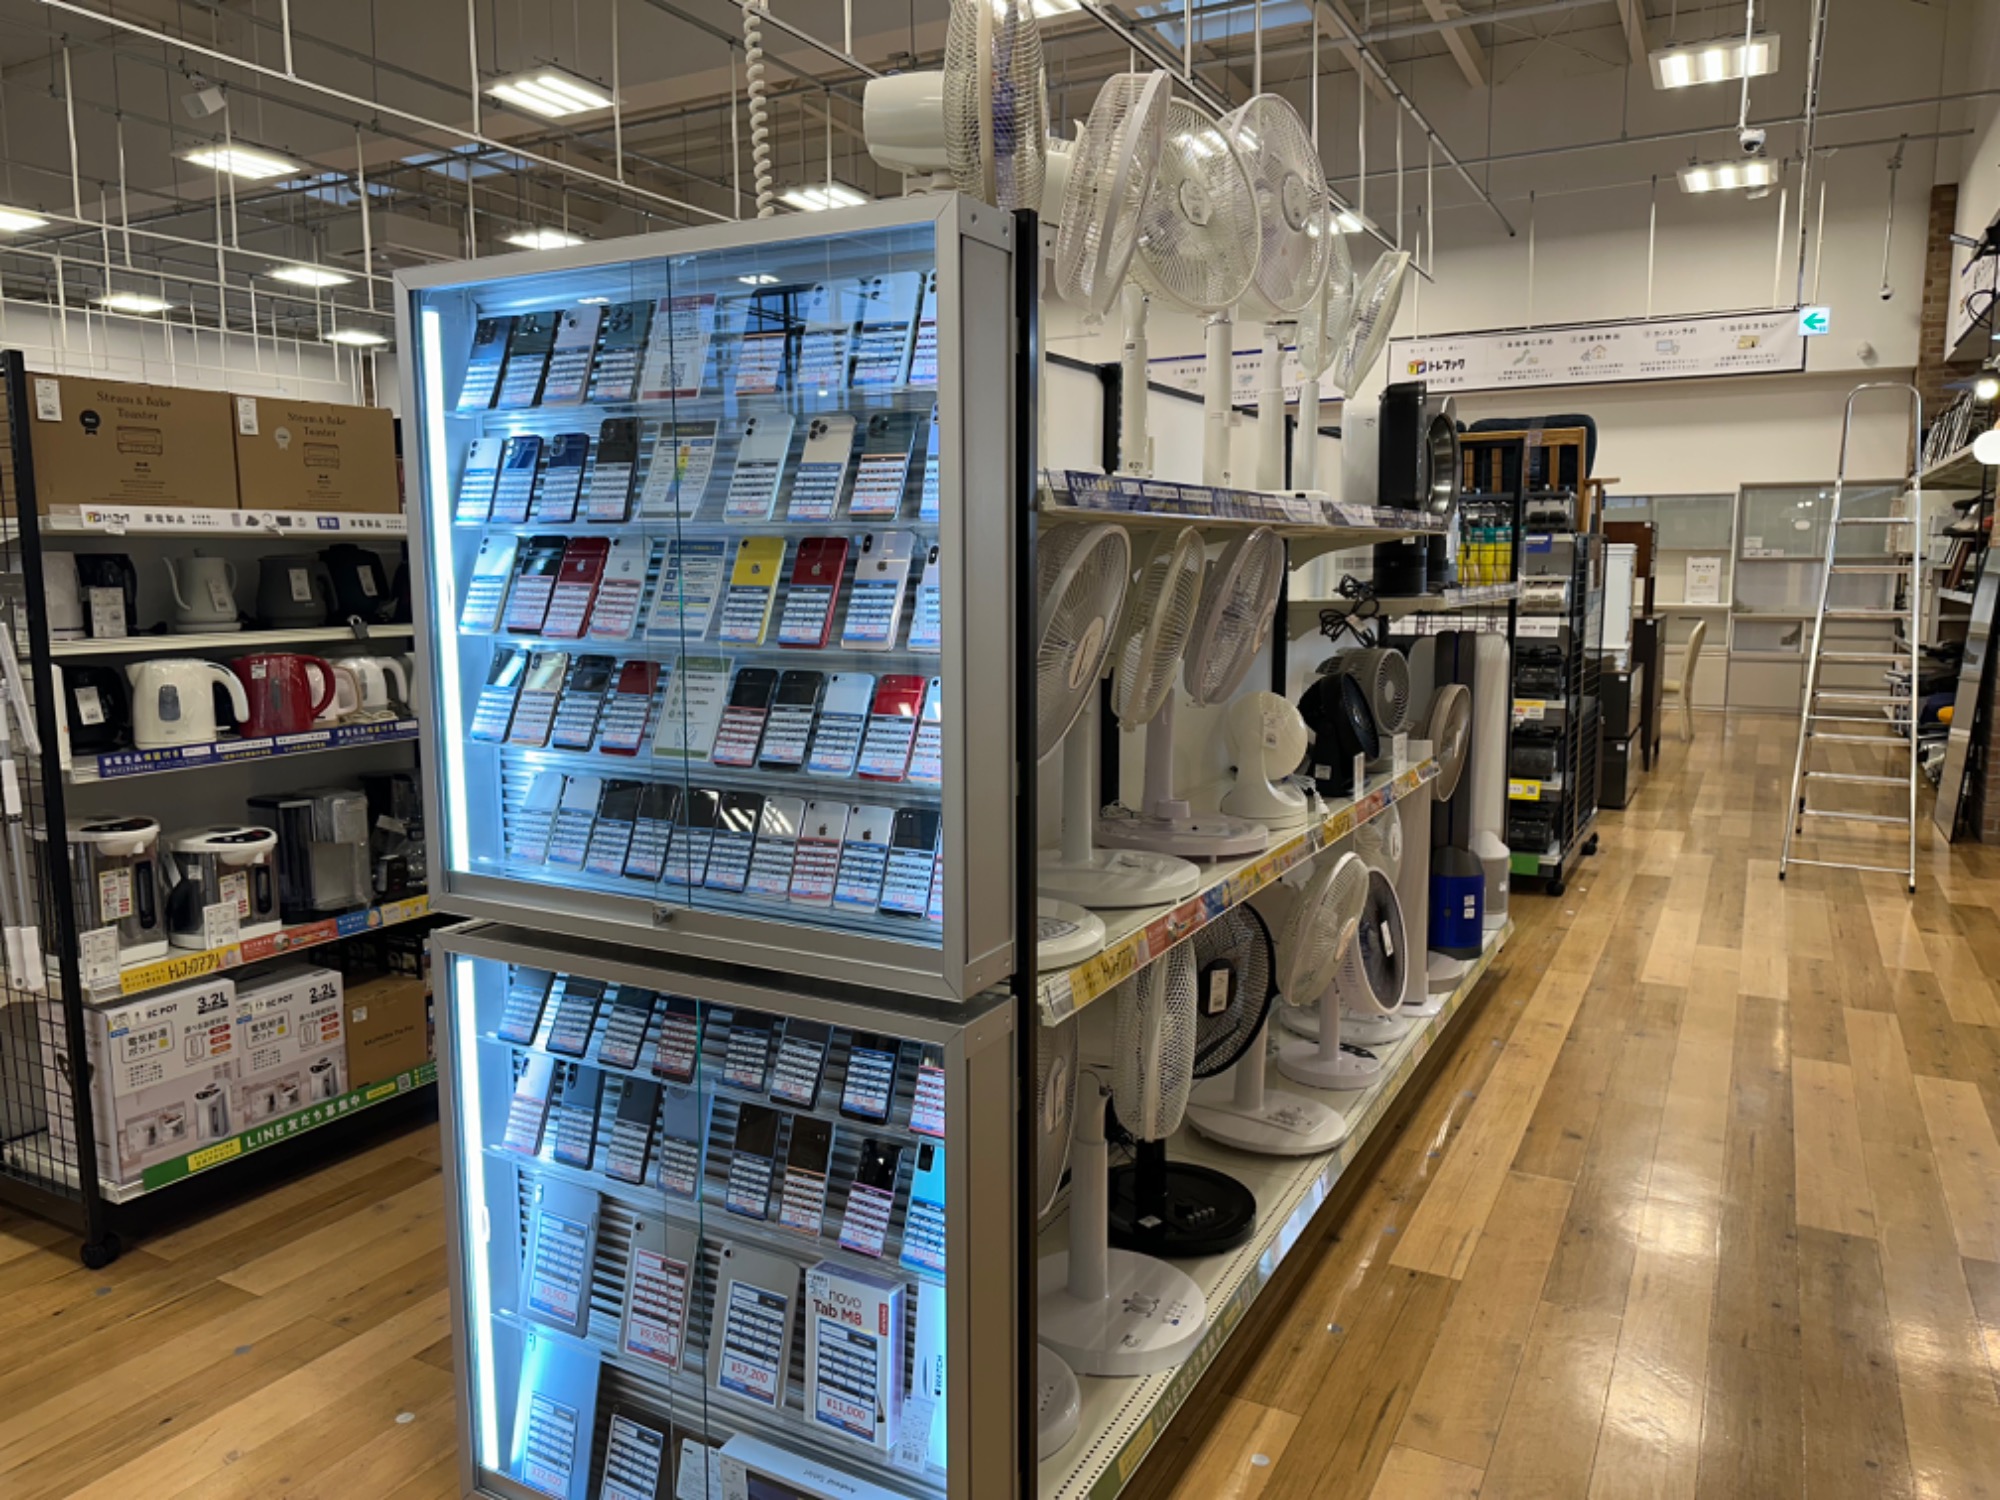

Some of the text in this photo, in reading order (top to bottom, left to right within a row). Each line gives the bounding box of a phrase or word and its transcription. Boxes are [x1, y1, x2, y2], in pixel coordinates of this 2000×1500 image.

[116, 407, 158, 421] Toaster
[813, 1298, 838, 1318] Tab
[841, 1308, 863, 1327] M8
